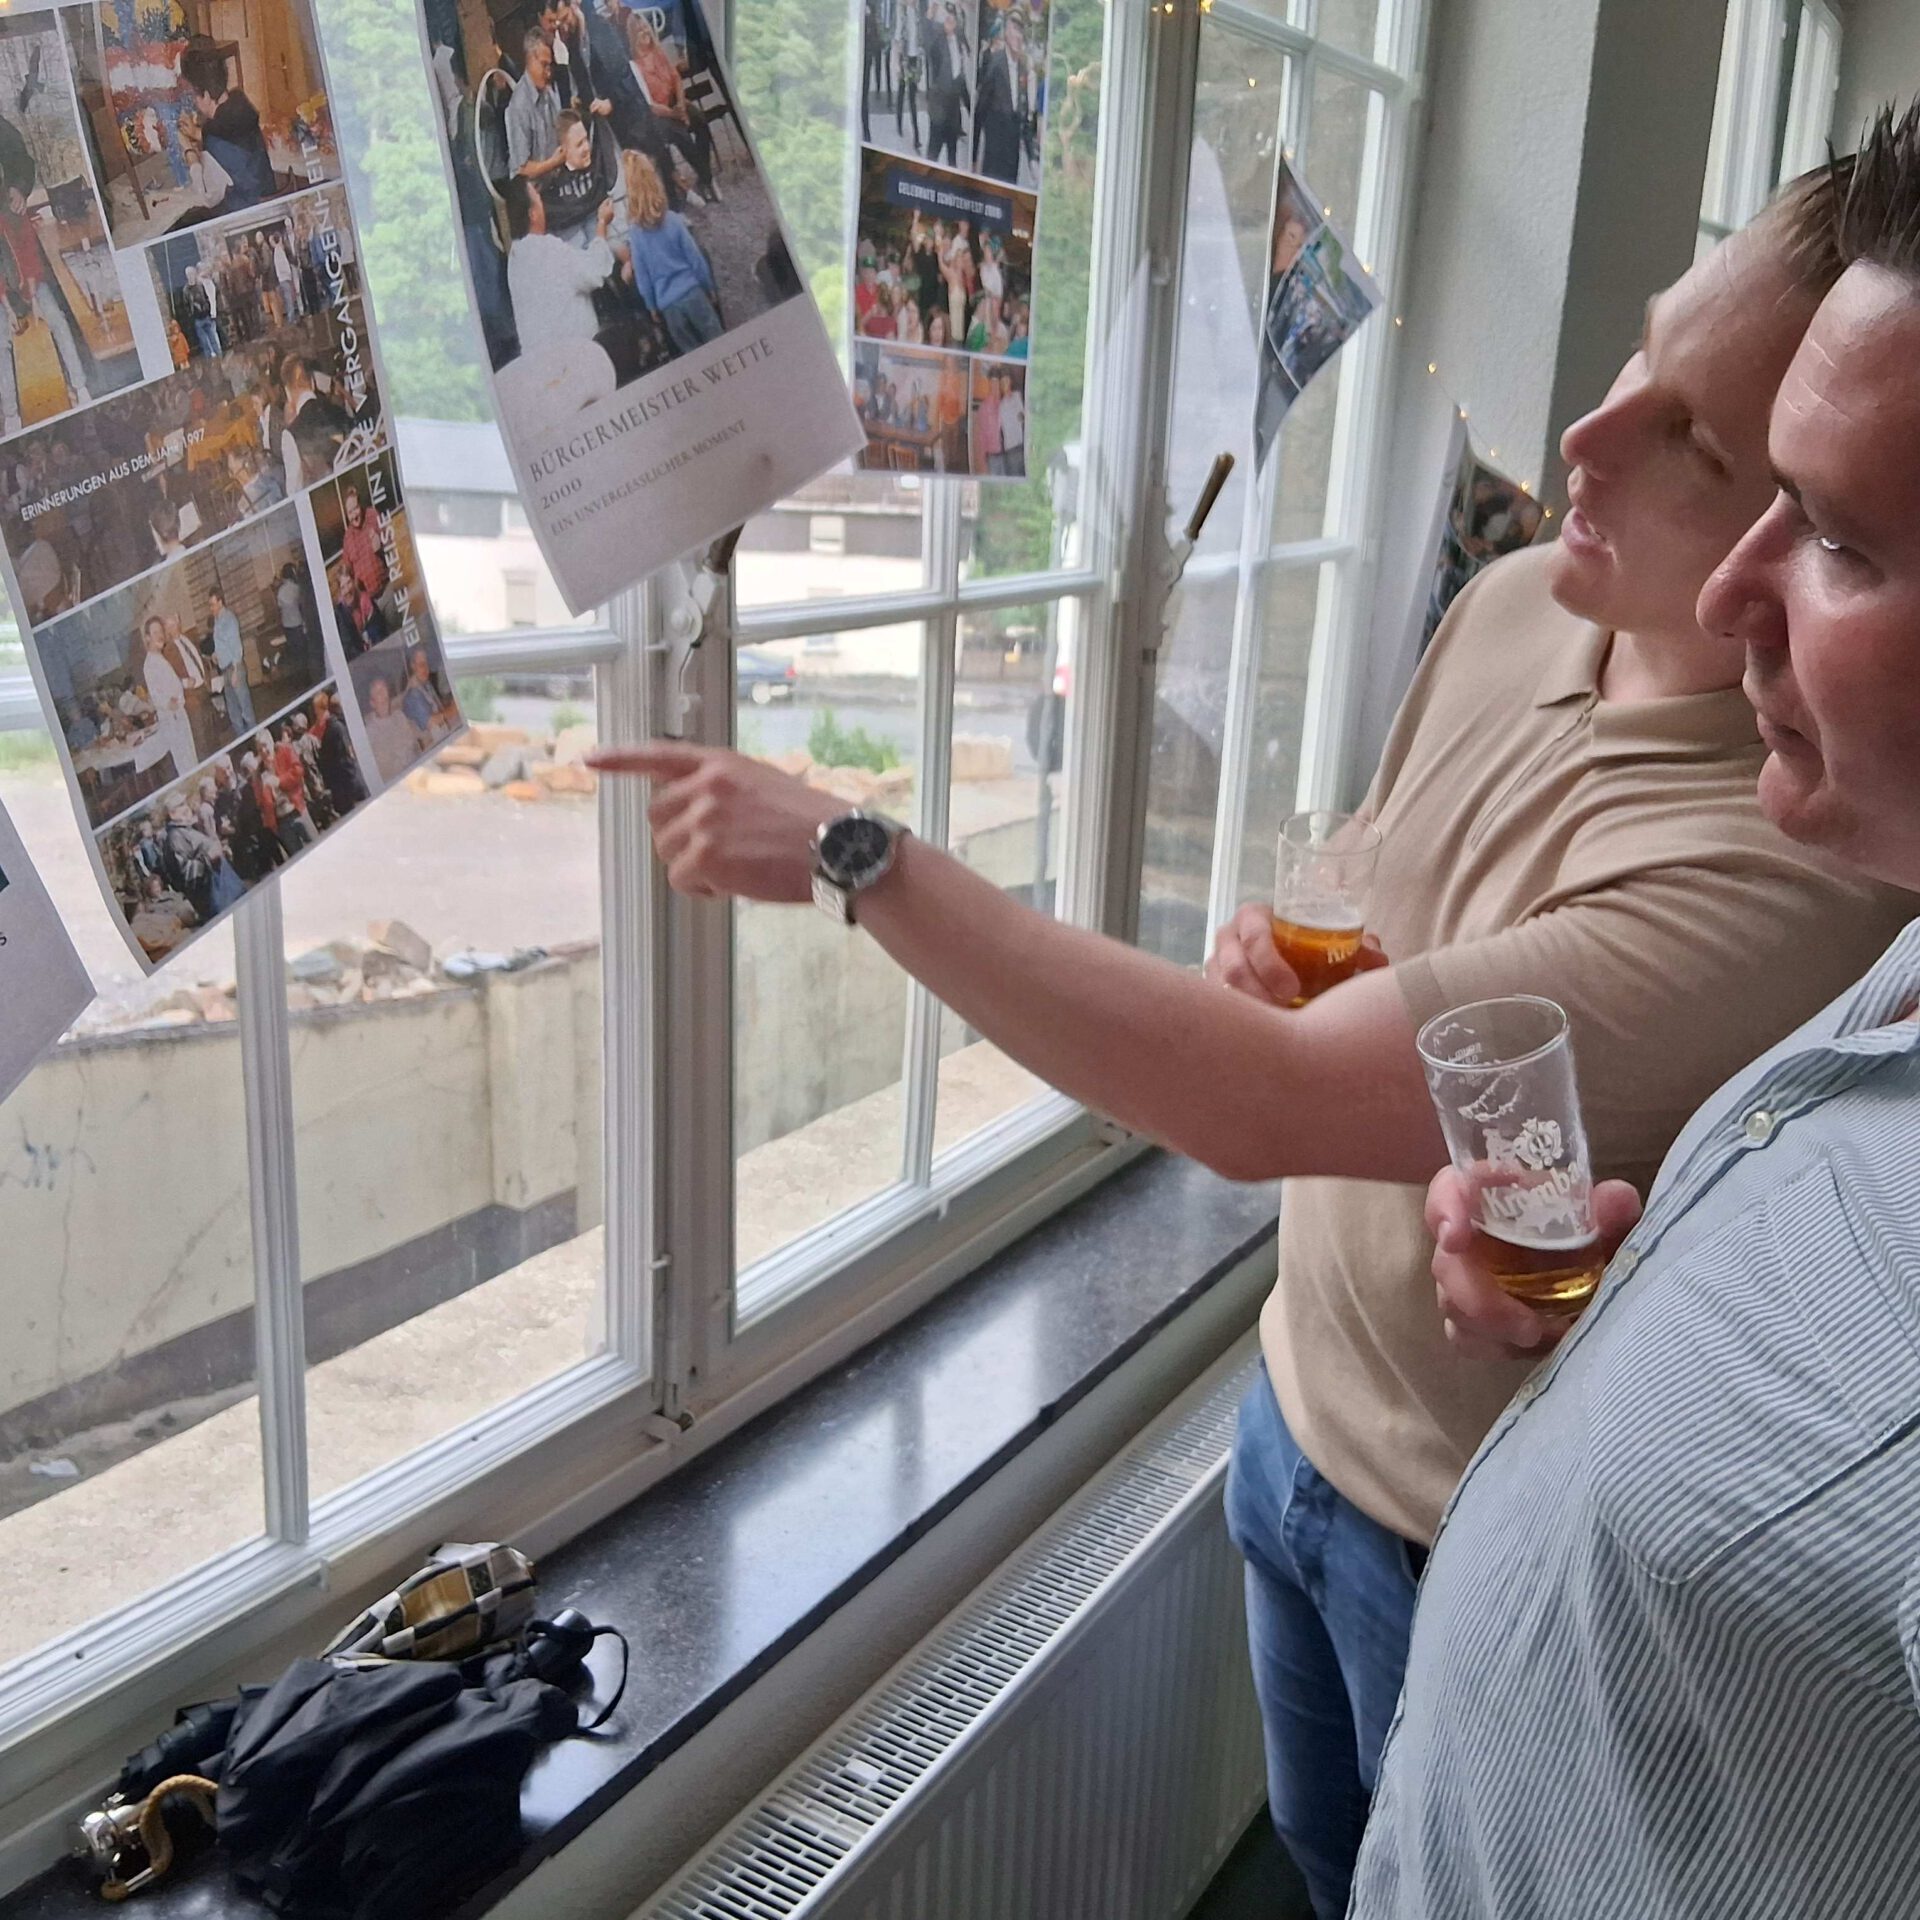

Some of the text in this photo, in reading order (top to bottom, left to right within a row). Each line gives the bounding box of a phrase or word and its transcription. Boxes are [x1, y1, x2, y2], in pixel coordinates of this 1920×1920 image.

[301, 142, 368, 413] VERGANGENHEIT
[529, 337, 774, 483] BÜRGERMEISTER WETTE
[21, 472, 107, 521] ERINNERUNGEN
[109, 462, 130, 483] AUS
[130, 452, 153, 473] DEM
[181, 428, 205, 449] 1997
[370, 471, 387, 505] IN
[541, 478, 583, 510] 2000
[550, 418, 747, 537] EIN UNVERGESSLICHER MOMENT
[377, 508, 404, 582] REISE
[394, 586, 420, 648] EINE
